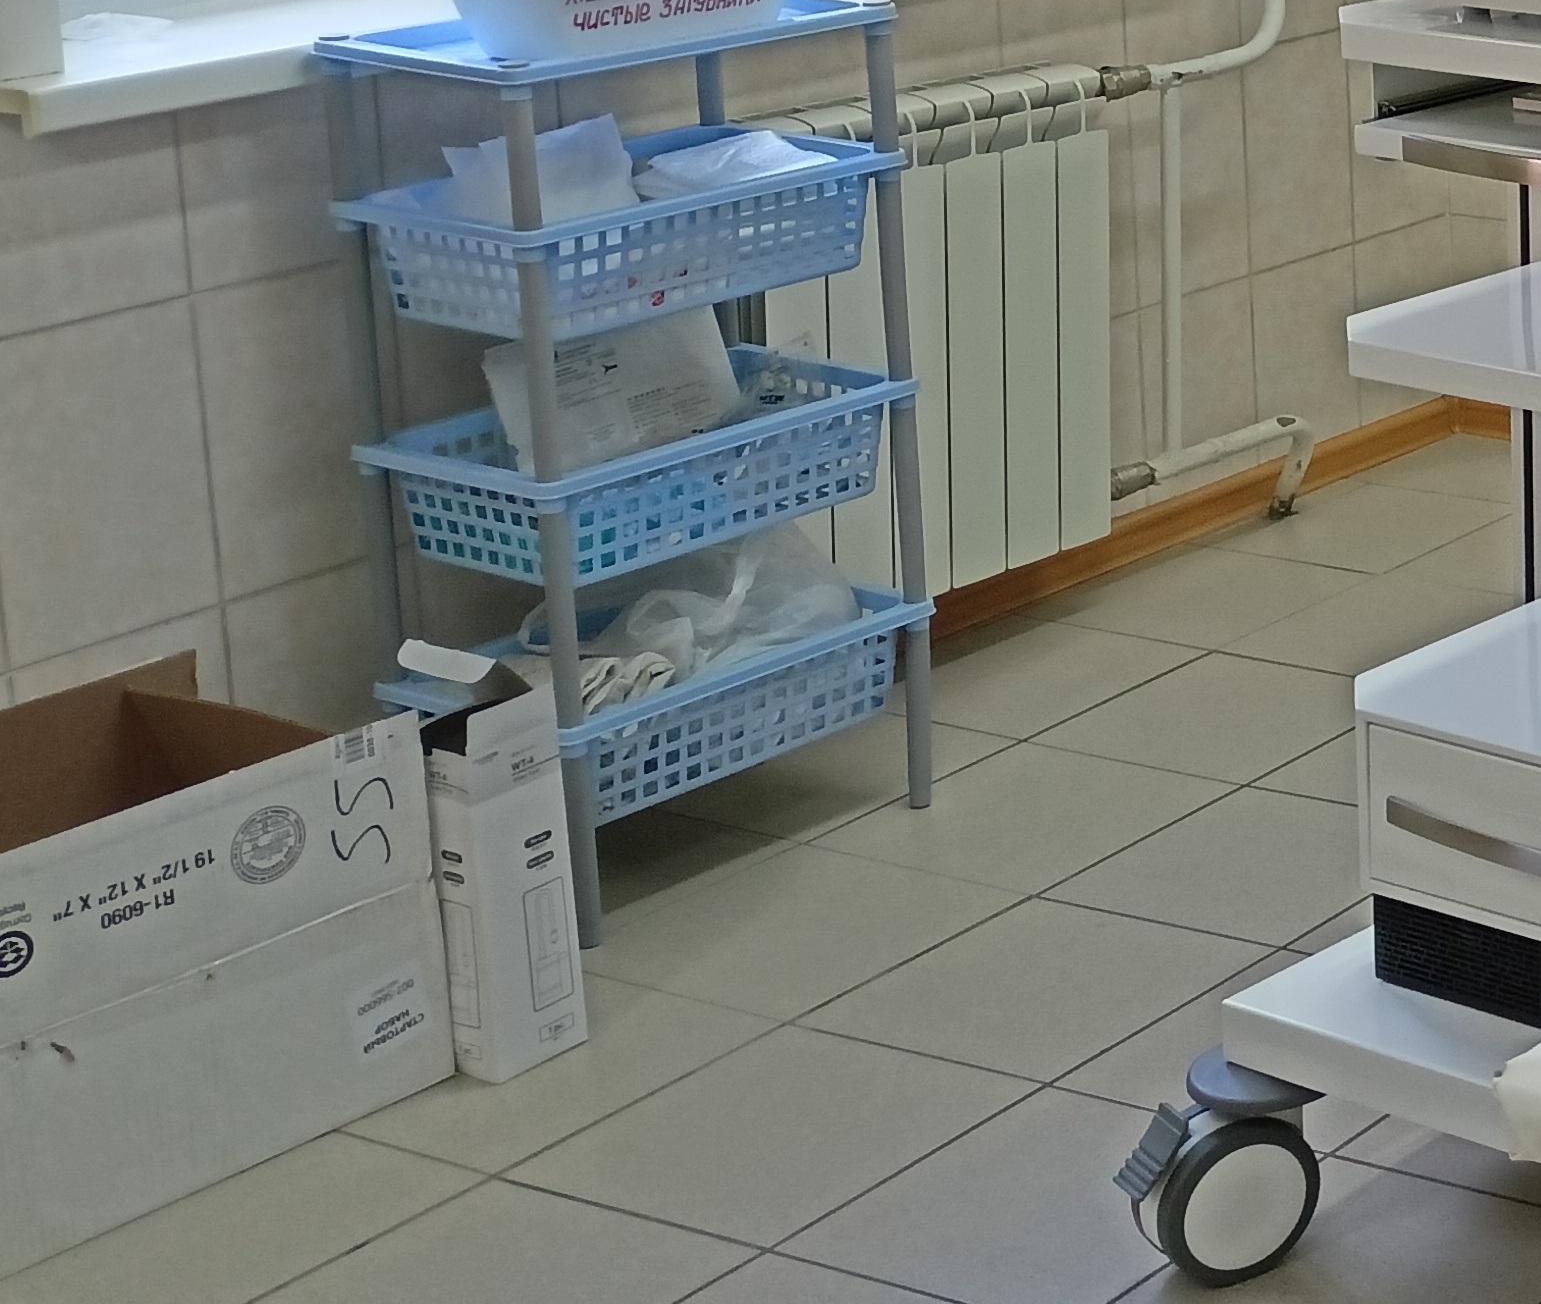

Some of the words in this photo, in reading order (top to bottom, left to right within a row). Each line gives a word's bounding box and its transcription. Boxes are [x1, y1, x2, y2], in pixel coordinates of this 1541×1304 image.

[194, 848, 215, 869] 19
[99, 881, 128, 905] 12"
[133, 873, 146, 892] X
[53, 900, 74, 922] 7"
[79, 893, 92, 912] X
[101, 888, 176, 929] R1-6090
